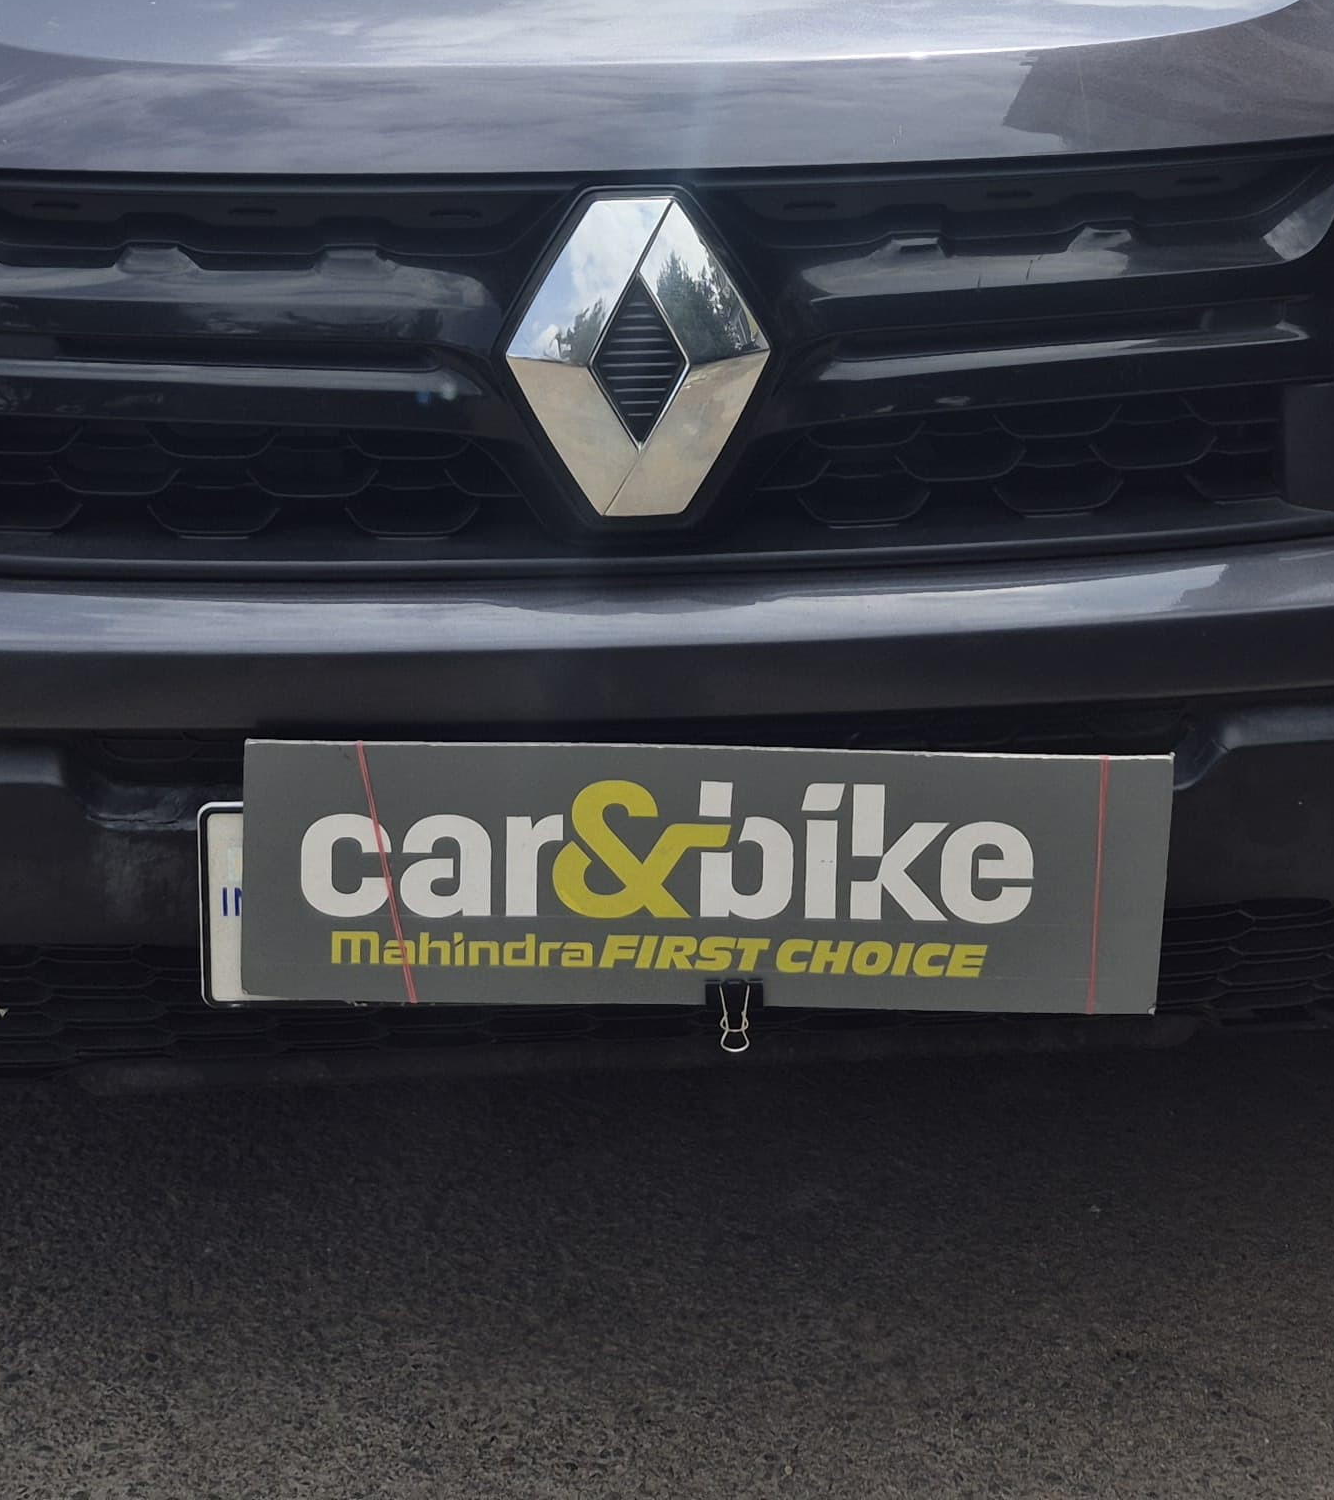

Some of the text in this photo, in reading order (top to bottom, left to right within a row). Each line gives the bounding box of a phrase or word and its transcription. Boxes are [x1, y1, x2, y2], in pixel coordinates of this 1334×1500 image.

[299, 780, 1034, 924] car&bike
[330, 930, 989, 978] Mahindra FIRST CHOICE
